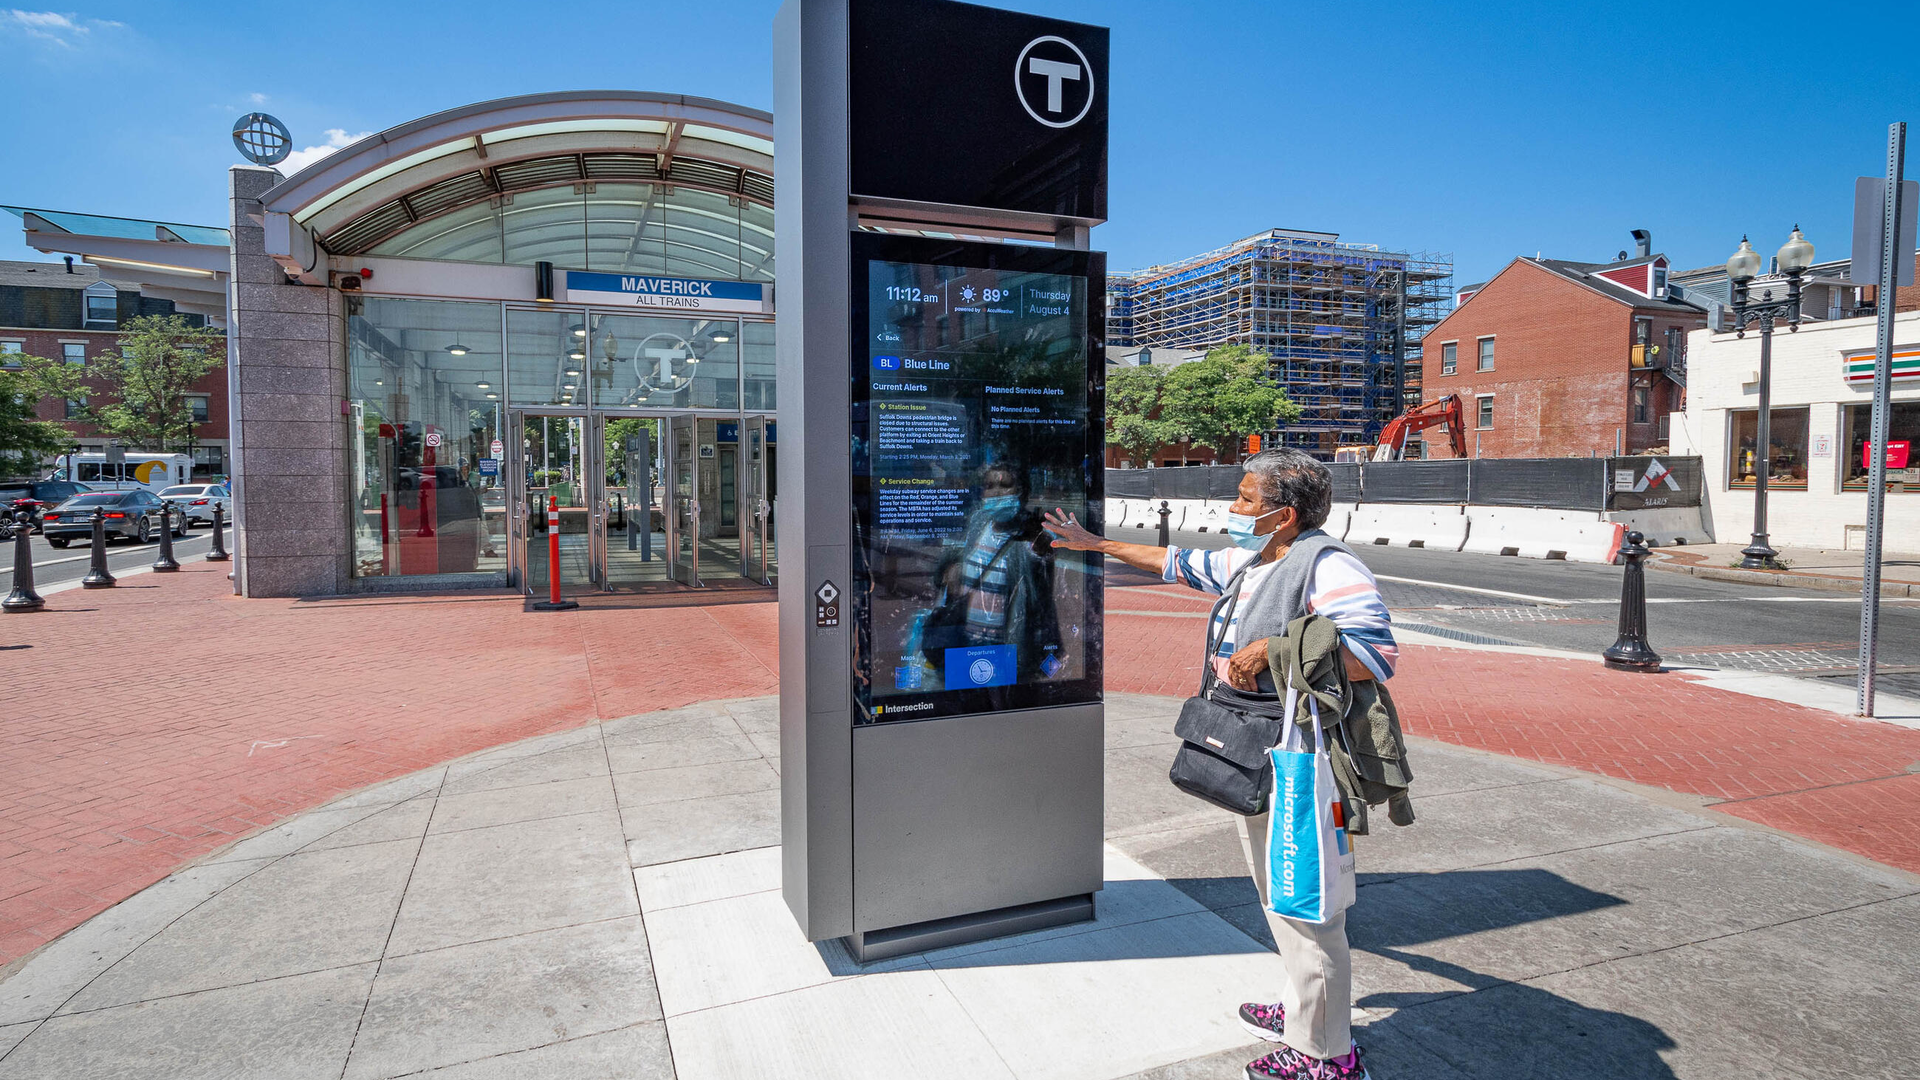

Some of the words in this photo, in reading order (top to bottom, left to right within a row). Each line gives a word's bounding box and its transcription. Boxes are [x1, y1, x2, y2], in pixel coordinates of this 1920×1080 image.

[1029, 57, 1080, 113] T
[621, 277, 712, 296] MAVERICK
[886, 286, 921, 302] 11:12
[923, 294, 938, 303] am
[983, 288, 1009, 302] 89°
[1030, 289, 1070, 302] Thursday
[636, 295, 654, 305] ALL
[660, 297, 700, 308] TRAINS
[1030, 304, 1061, 316] August
[1064, 306, 1070, 315] 4
[885, 334, 899, 342] Back
[645, 348, 686, 383] T
[880, 359, 893, 368] BL
[904, 359, 927, 369] Blue
[929, 360, 949, 370] Line
[873, 383, 902, 391] Current
[904, 384, 927, 392] Alerts
[985, 386, 1014, 394] Planned
[1015, 387, 1041, 395] Service
[1043, 388, 1064, 396] Alerts
[967, 649, 995, 657] Departures
[885, 702, 933, 714] Intersection
[1283, 777, 1298, 897] microsoft.com
